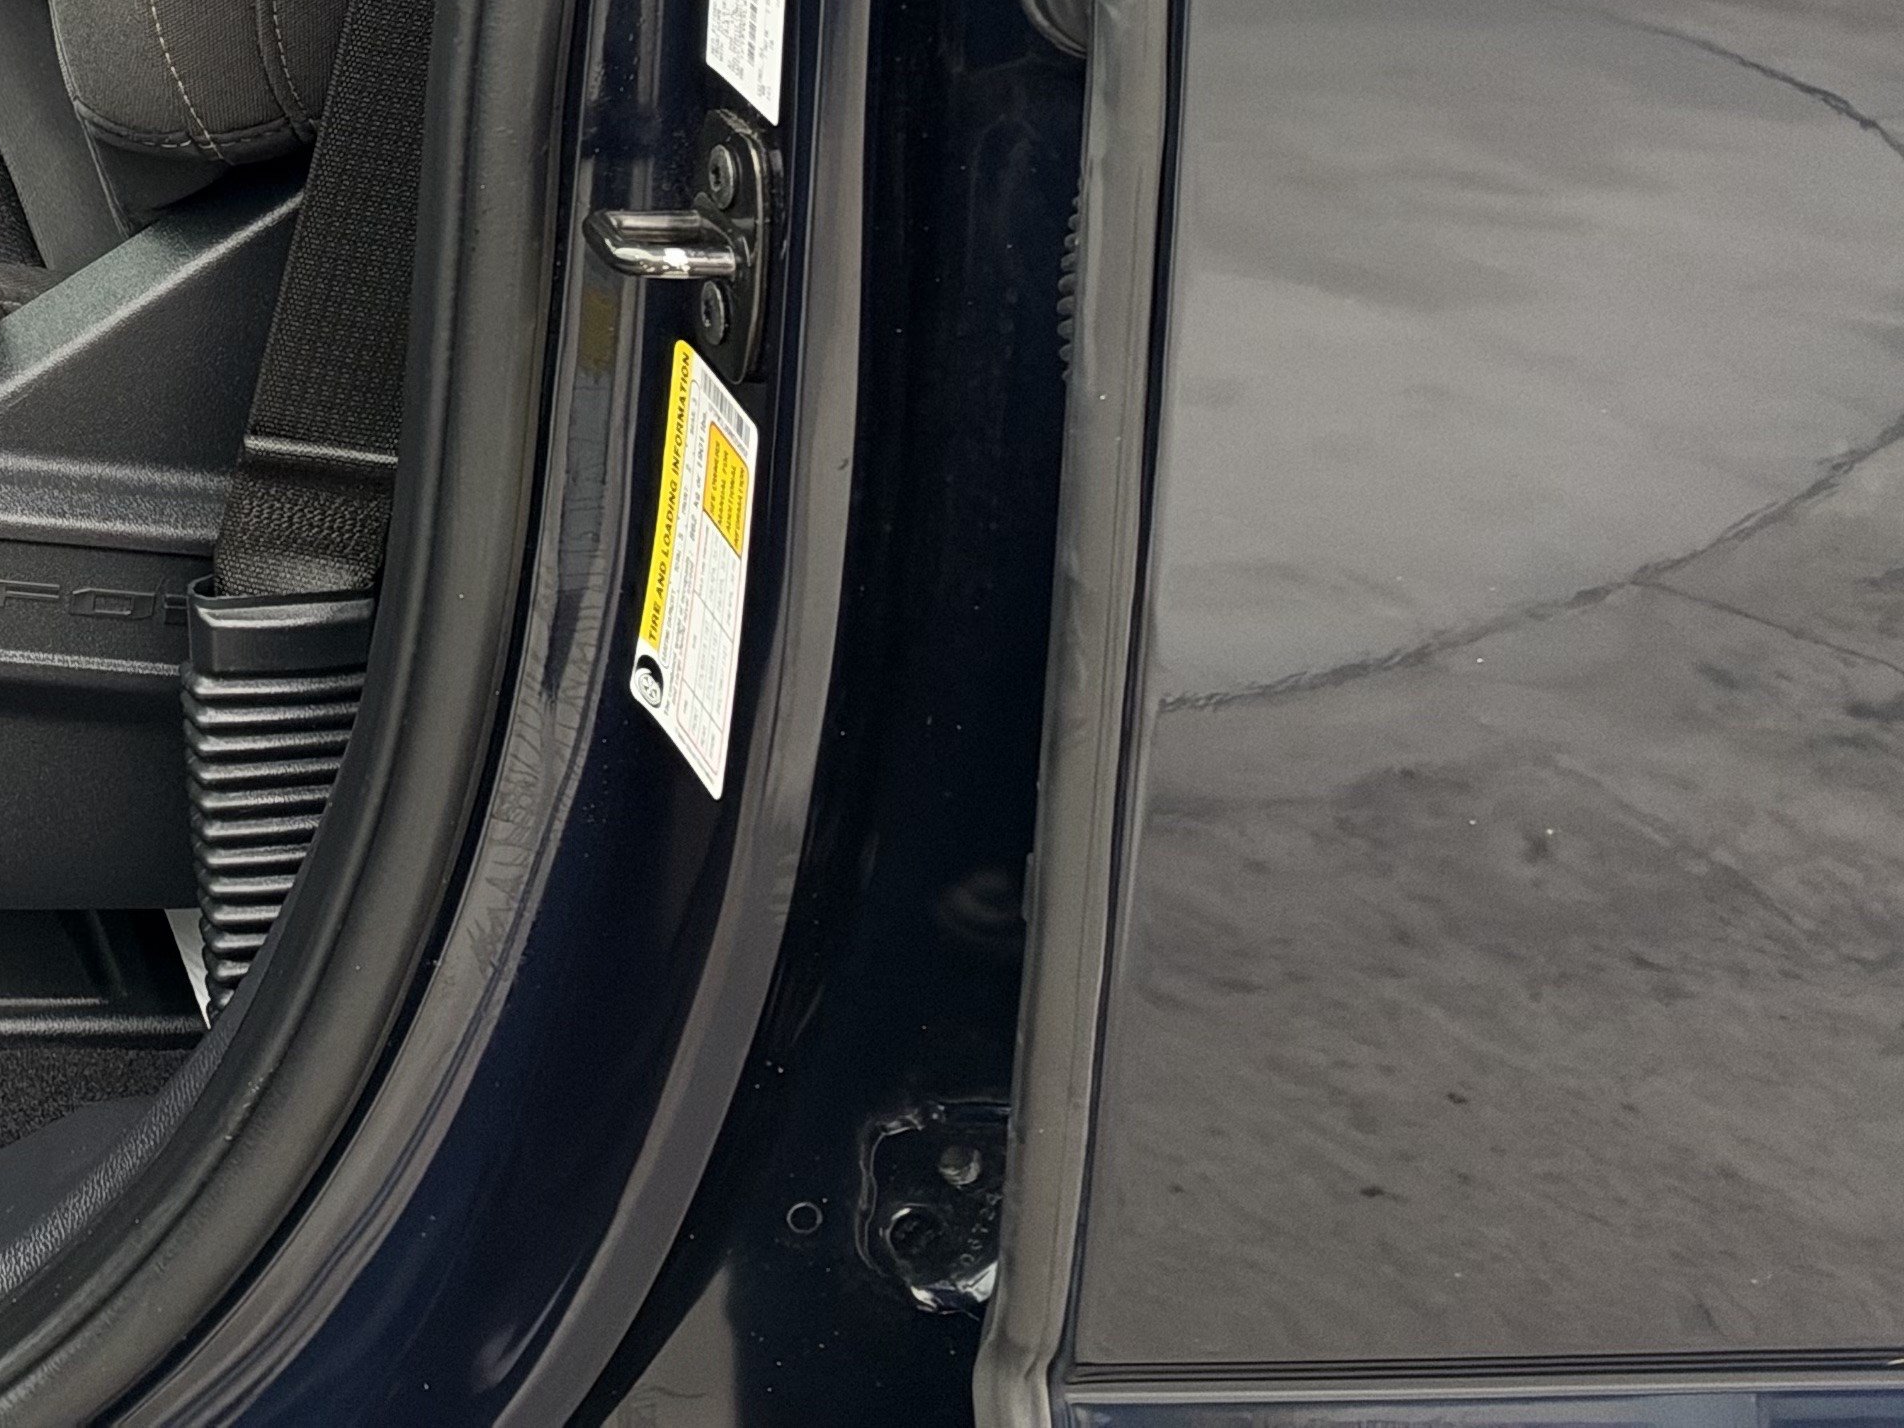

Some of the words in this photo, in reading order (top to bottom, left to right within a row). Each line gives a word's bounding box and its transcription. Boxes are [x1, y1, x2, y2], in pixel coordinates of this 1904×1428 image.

[671, 349, 689, 476] INFORMATION
[660, 476, 677, 559] LOADING
[655, 557, 666, 600] AND
[648, 598, 660, 645] TIRE
